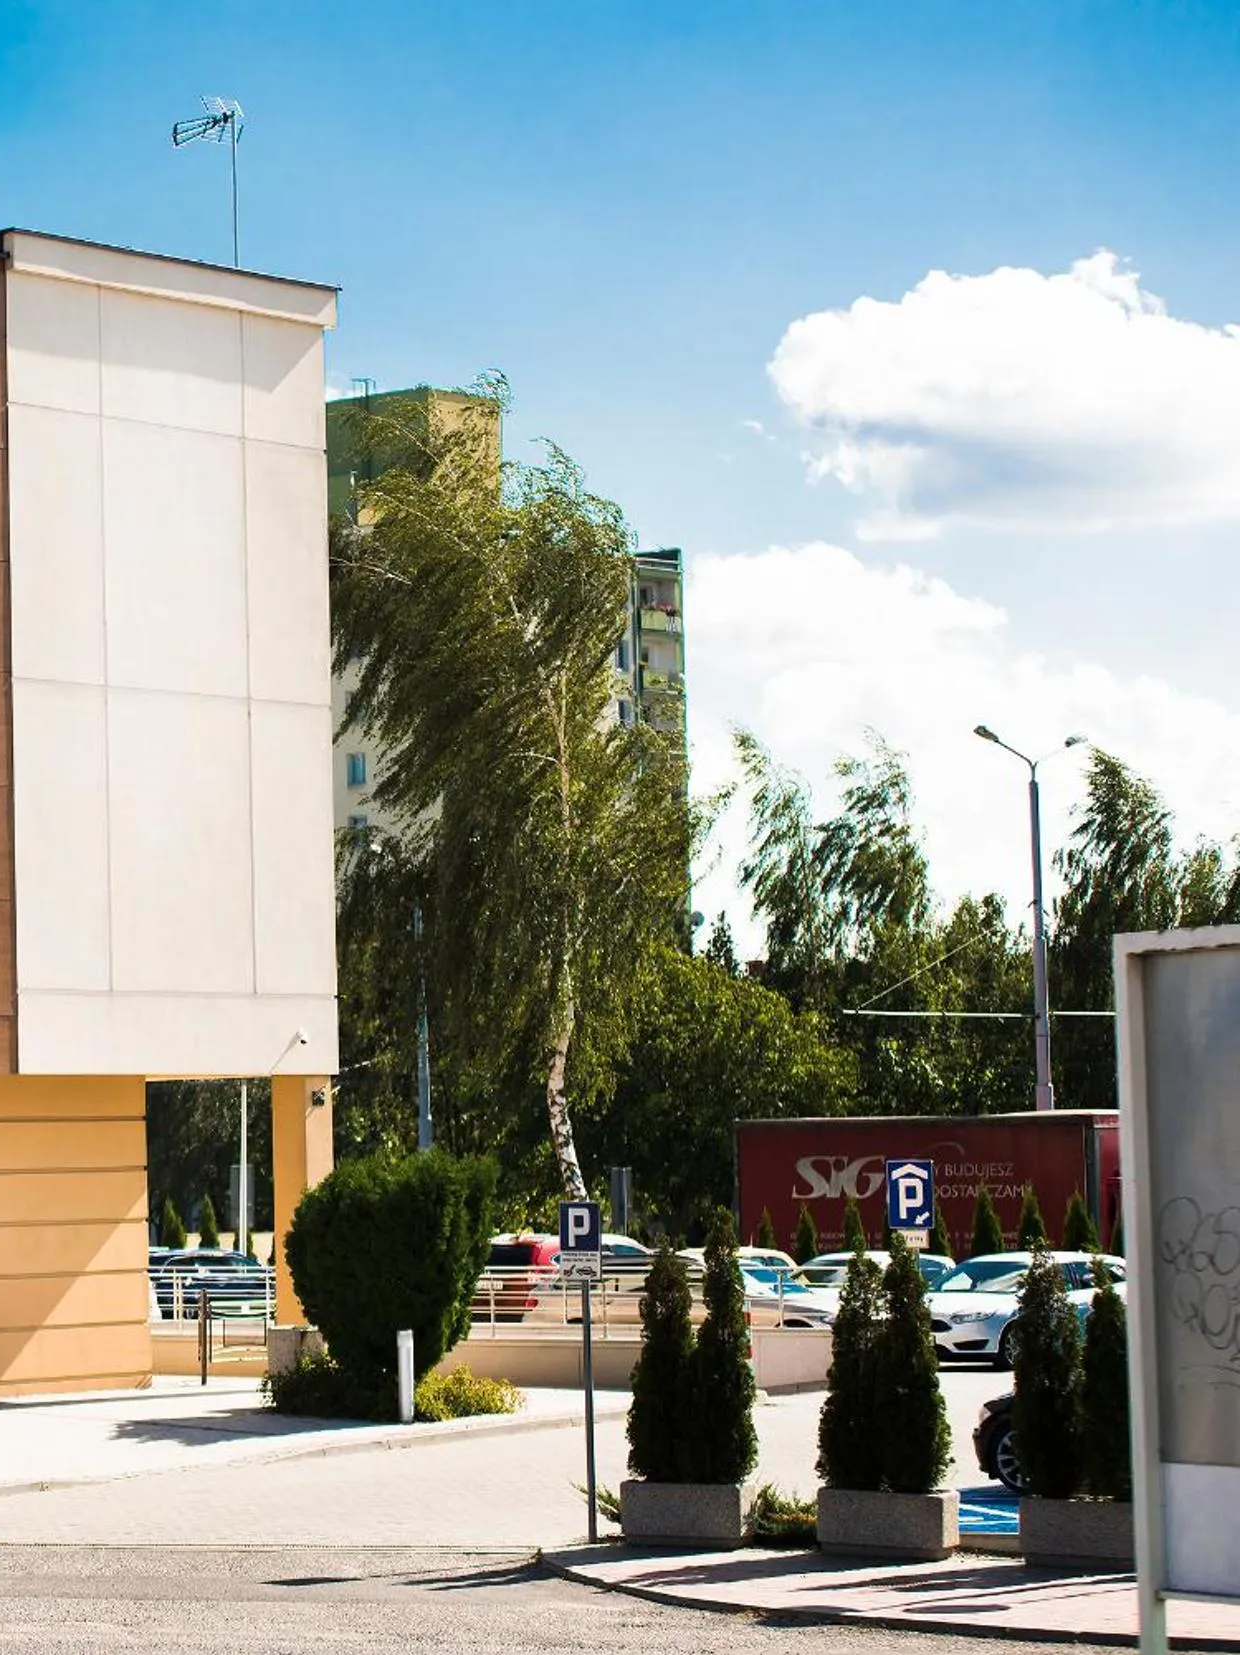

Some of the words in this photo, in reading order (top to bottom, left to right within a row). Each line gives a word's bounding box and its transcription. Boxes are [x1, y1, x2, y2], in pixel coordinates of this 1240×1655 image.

[944, 1162, 1014, 1178] BUDUJESZ
[898, 1178, 923, 1219] P
[568, 1207, 590, 1248] P
